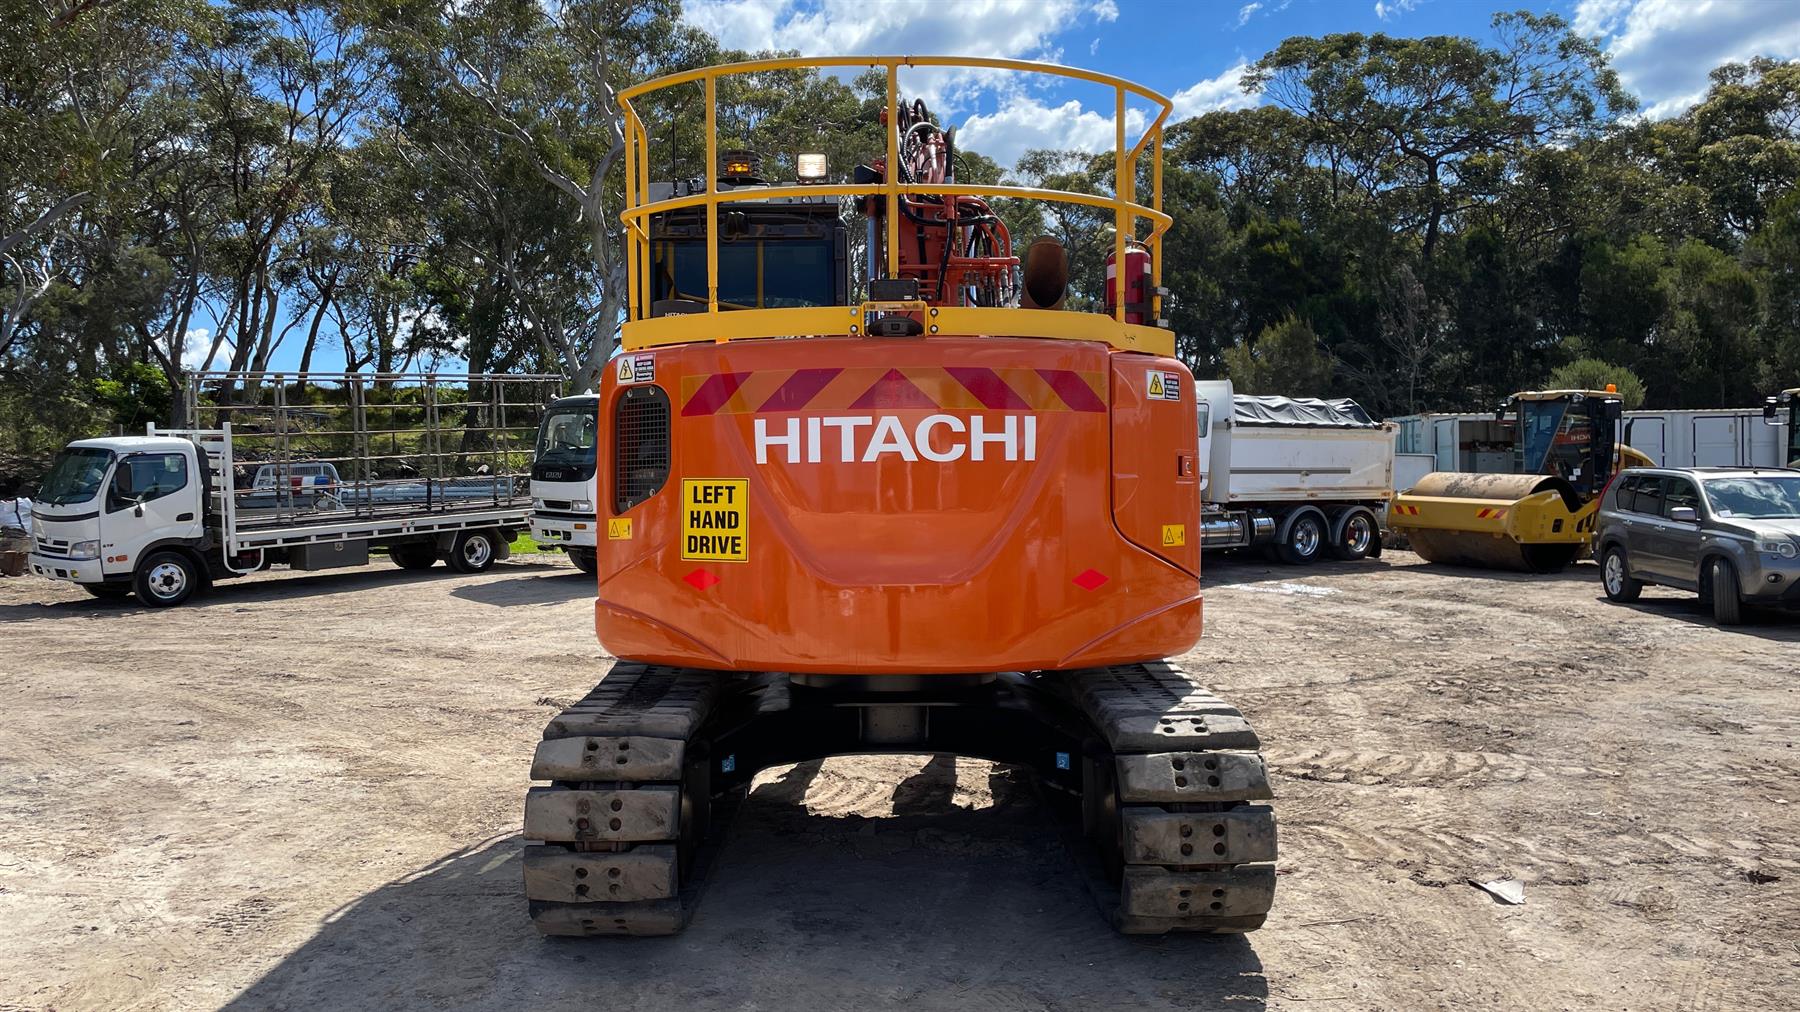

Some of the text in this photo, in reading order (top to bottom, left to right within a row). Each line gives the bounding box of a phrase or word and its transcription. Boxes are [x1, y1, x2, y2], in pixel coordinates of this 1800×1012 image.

[754, 414, 1037, 464] HITACHI
[693, 485, 736, 504] LEFT
[690, 510, 739, 529] HAND
[687, 535, 741, 554] DRIVE
